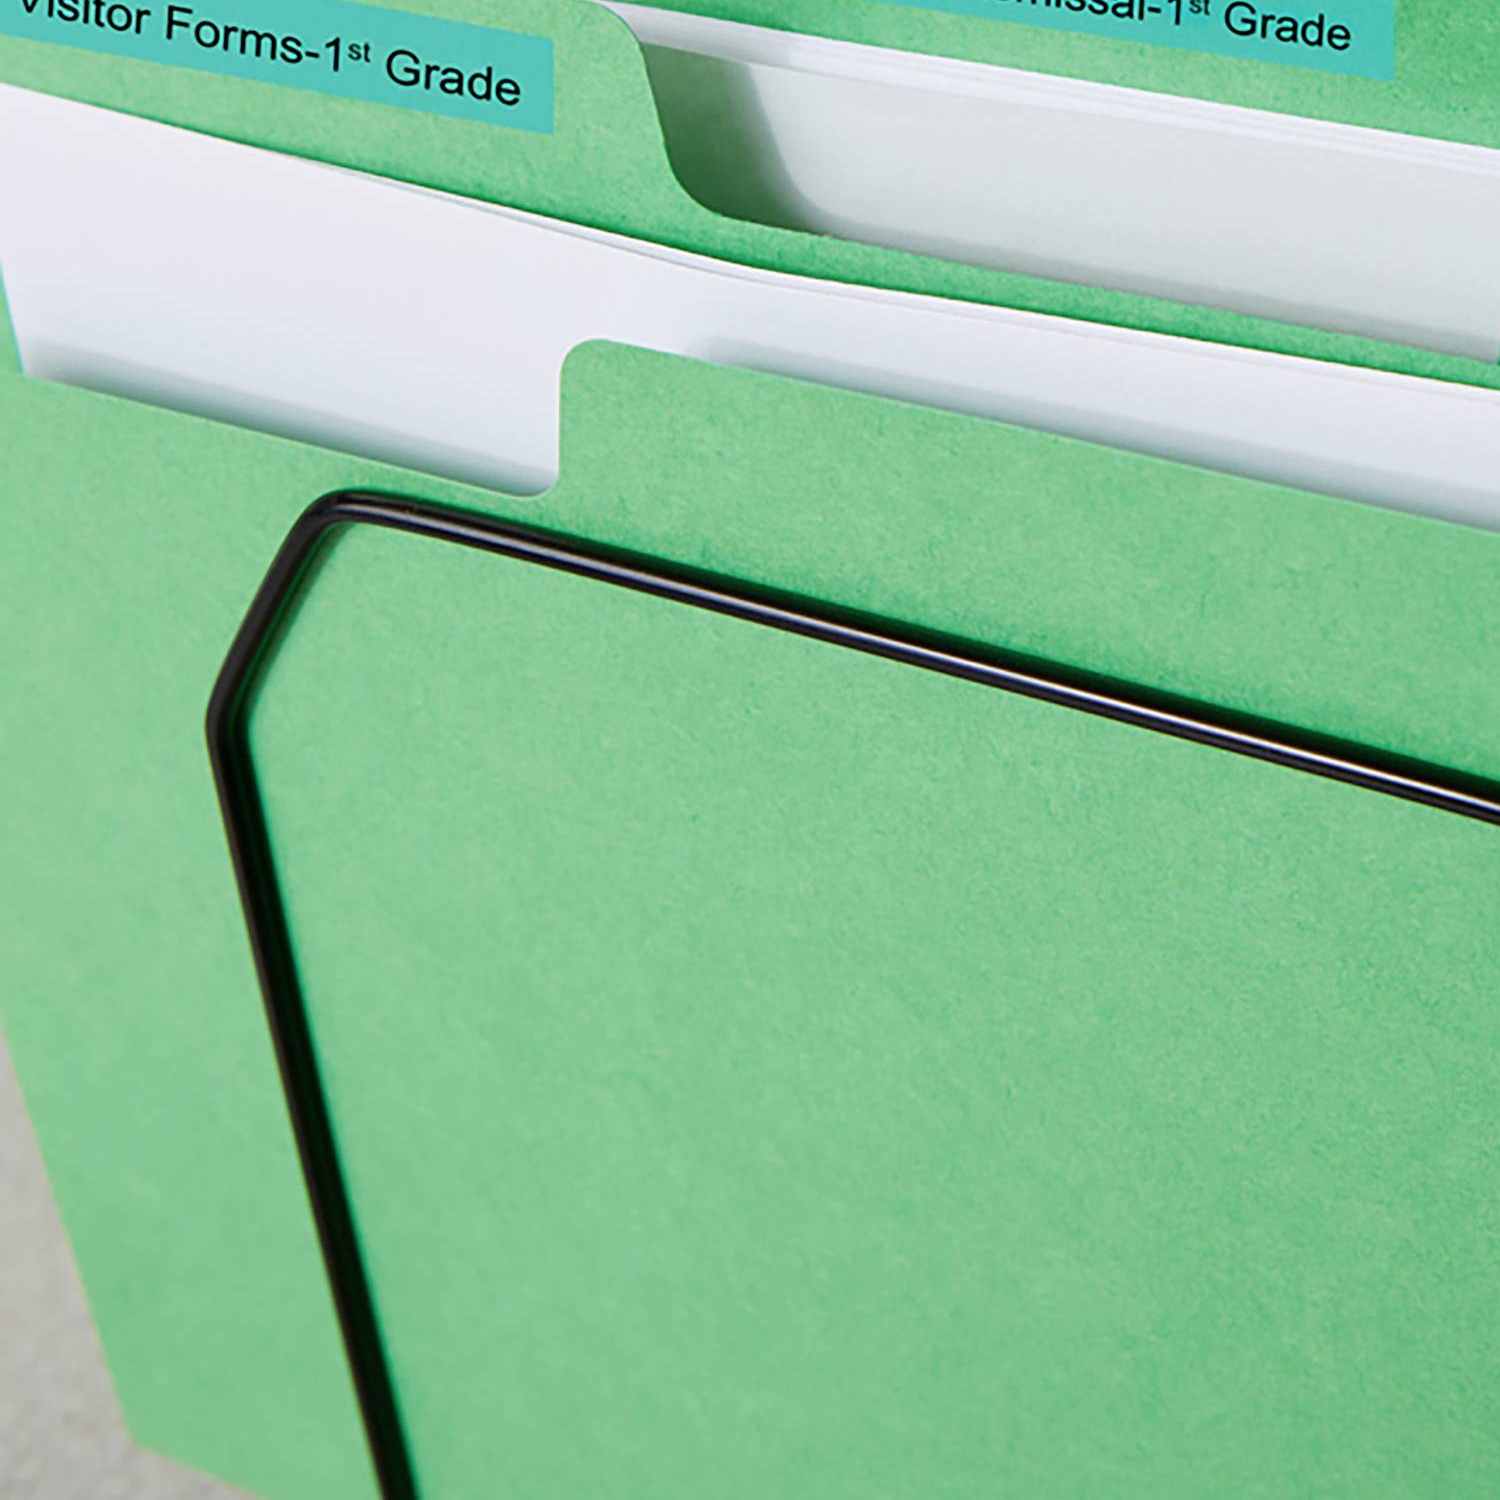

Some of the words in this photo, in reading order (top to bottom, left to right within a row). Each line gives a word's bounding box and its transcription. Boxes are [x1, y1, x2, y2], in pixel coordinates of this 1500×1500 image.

[165, 4, 371, 73] Forms-1st
[385, 49, 521, 107] Grade
[1224, 1, 1351, 51] Grade
